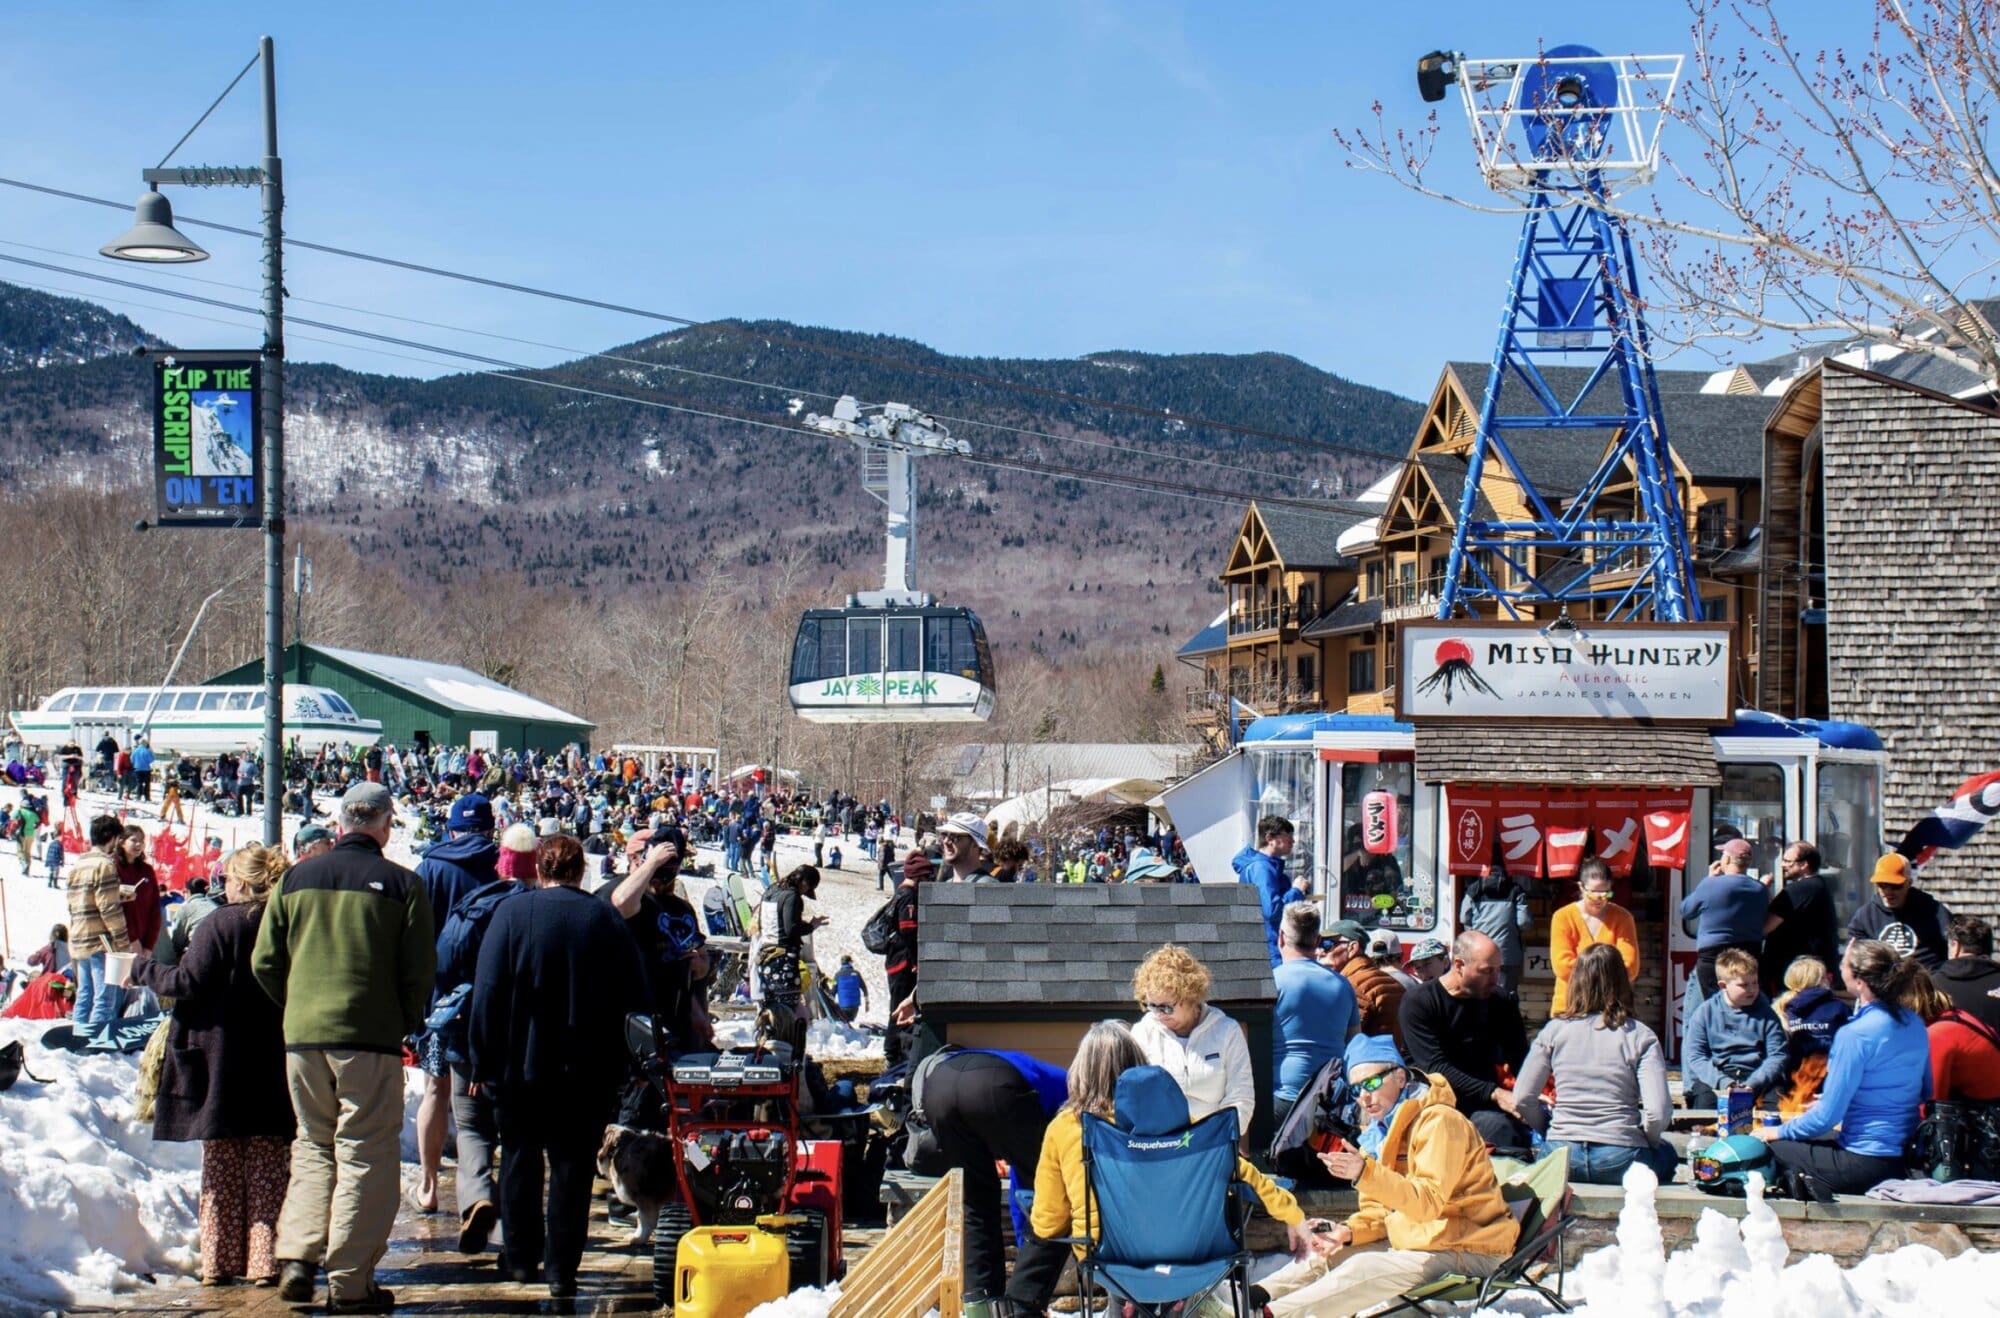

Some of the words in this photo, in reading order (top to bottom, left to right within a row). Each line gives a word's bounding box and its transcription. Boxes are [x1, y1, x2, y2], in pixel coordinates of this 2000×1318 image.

[164, 369, 208, 389] FLIP
[213, 369, 252, 389] THE
[163, 391, 191, 476] SCRIPT
[165, 478, 203, 504] ON
[1487, 643, 1572, 666] MISO
[1587, 642, 1722, 666] HUNGRY
[821, 681, 853, 696] JAY
[886, 680, 938, 696] PEAK
[1559, 672, 1649, 684] Authentic
[1517, 690, 1615, 699] JAPANESE
[1627, 691, 1692, 700] RAMEN
[1367, 802, 1385, 843] ラーメン
[1501, 814, 1687, 860] ラーメン
